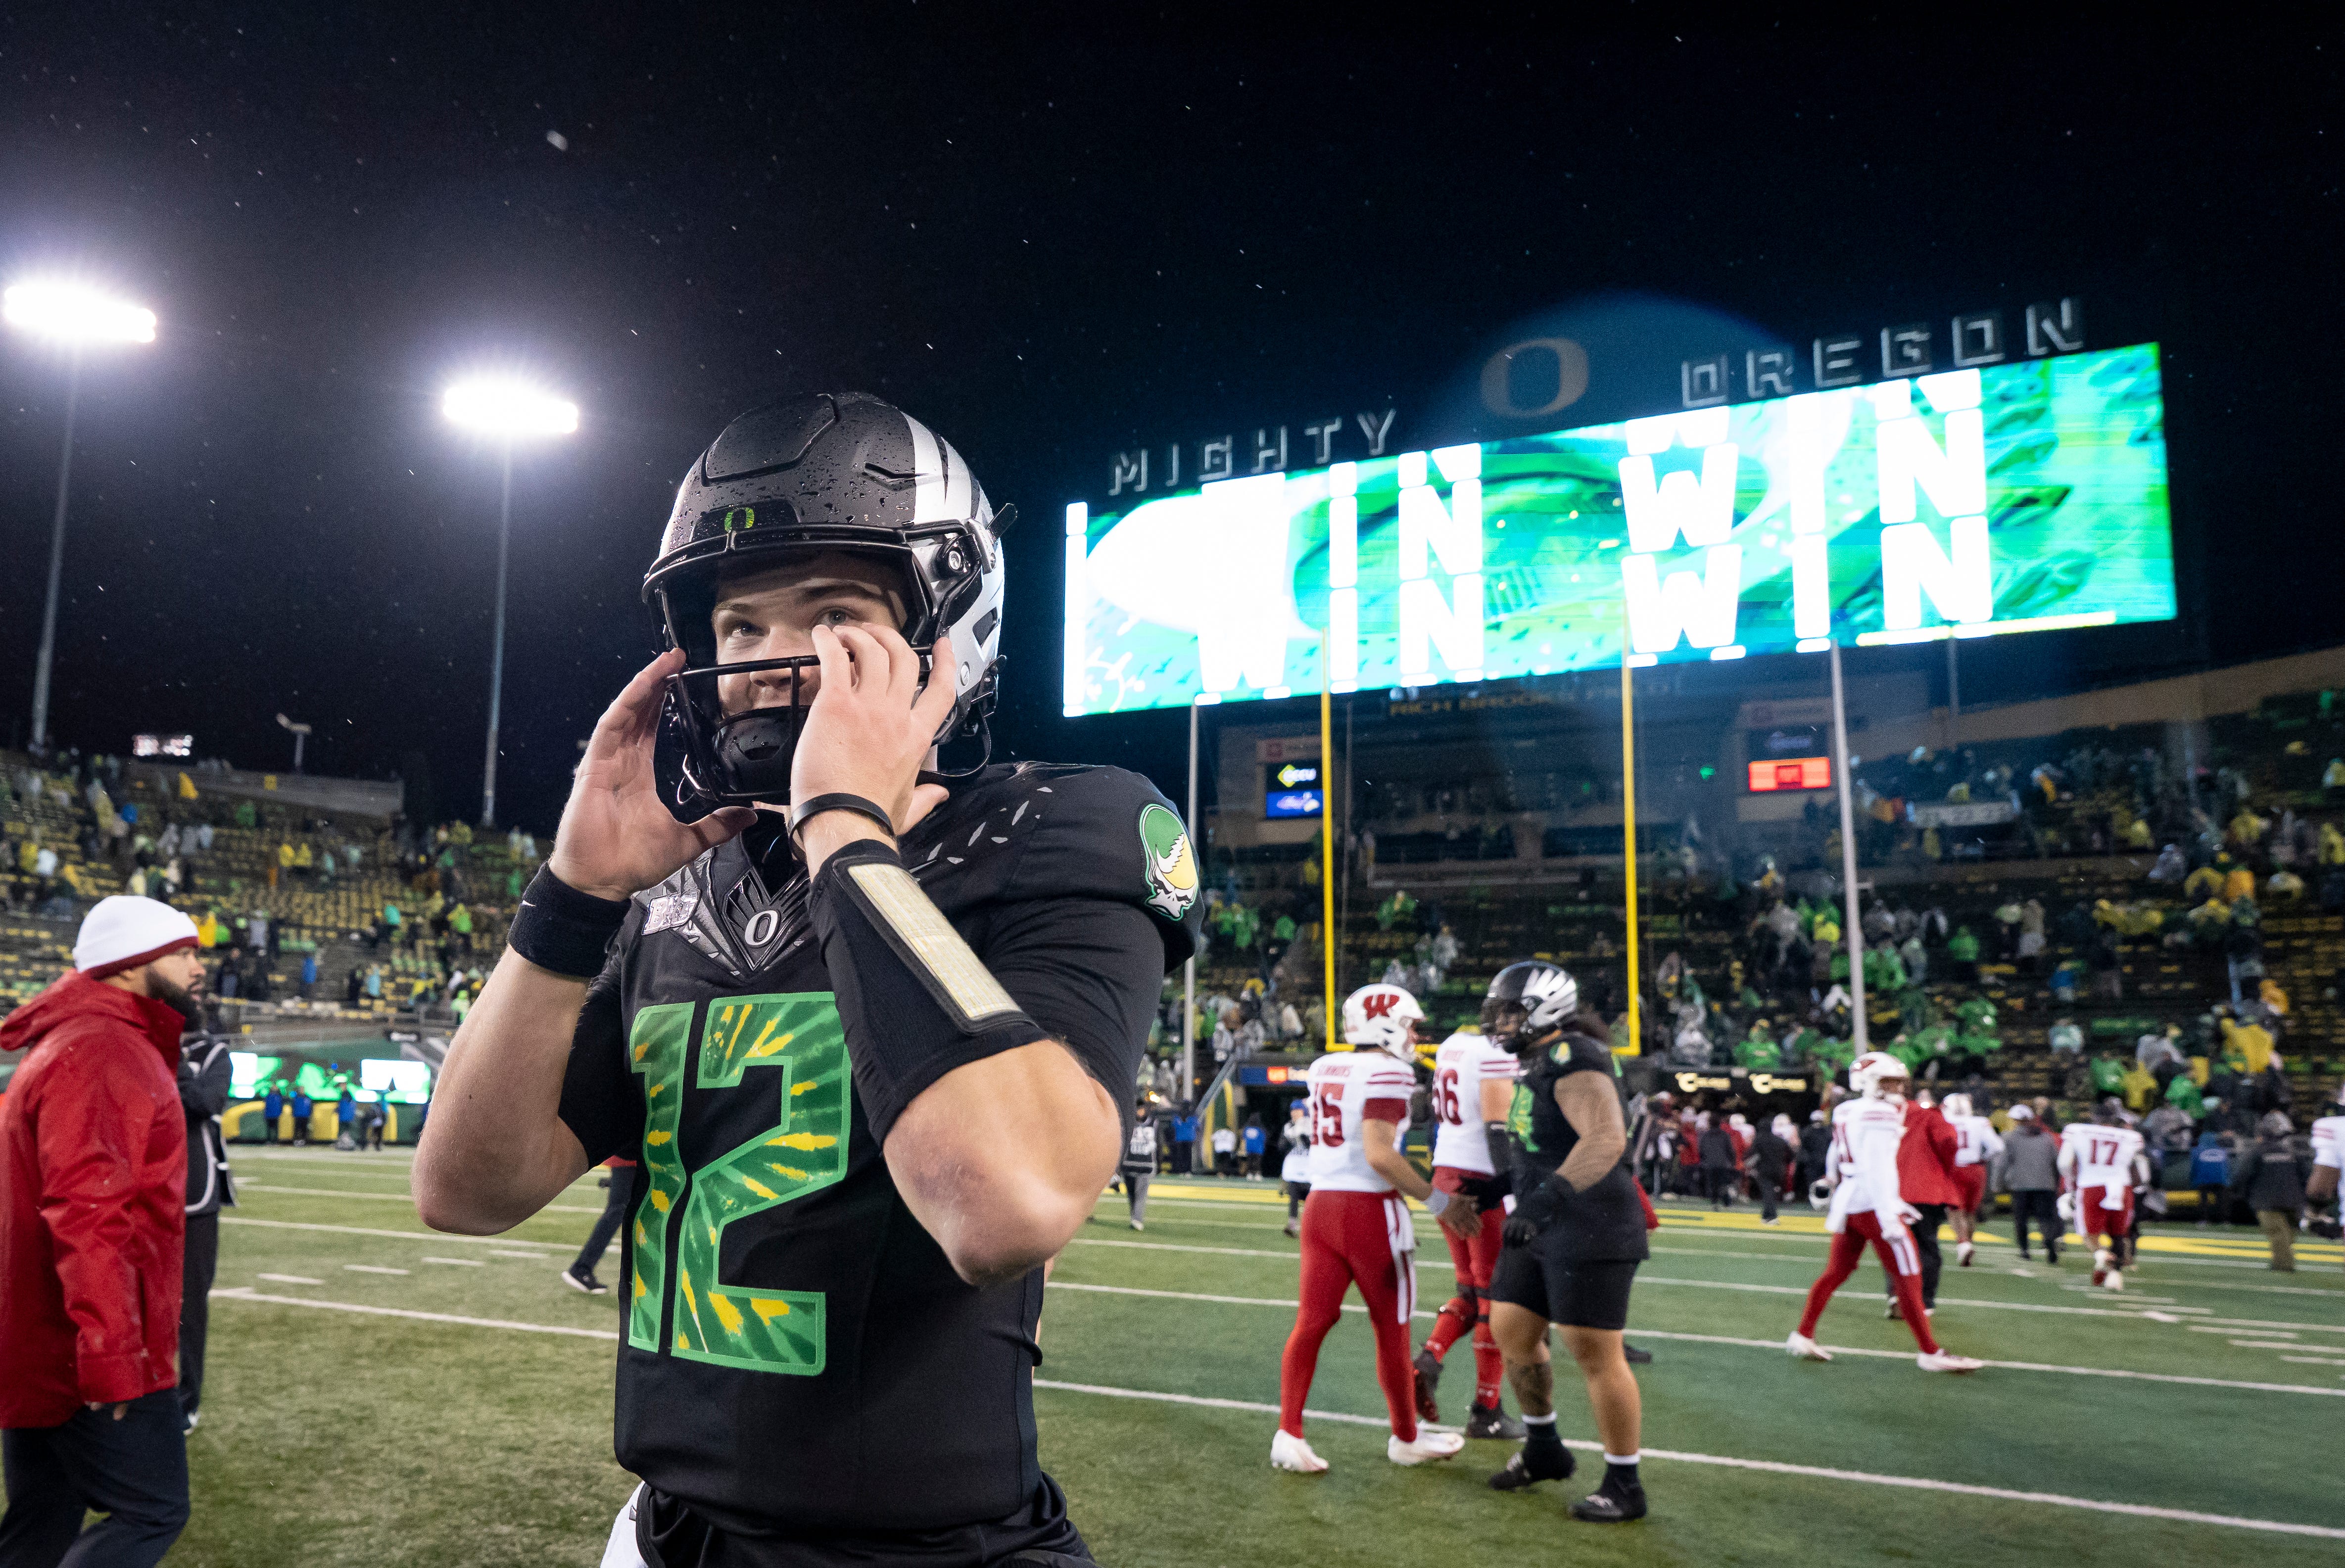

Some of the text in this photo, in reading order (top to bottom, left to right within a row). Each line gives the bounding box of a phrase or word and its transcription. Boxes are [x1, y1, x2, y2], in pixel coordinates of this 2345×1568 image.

[1108, 409, 1396, 495] MIGHTY
[1481, 336, 1588, 418] O
[1682, 297, 2083, 409] OREGON
[1619, 408, 1986, 553] WIN
[1622, 516, 1993, 653] WIN
[744, 910, 779, 947] O
[1363, 994, 1399, 1021] W
[1310, 1082, 1345, 1147] 15
[2090, 1139, 2119, 1165] 17
[629, 992, 852, 1376] 12
